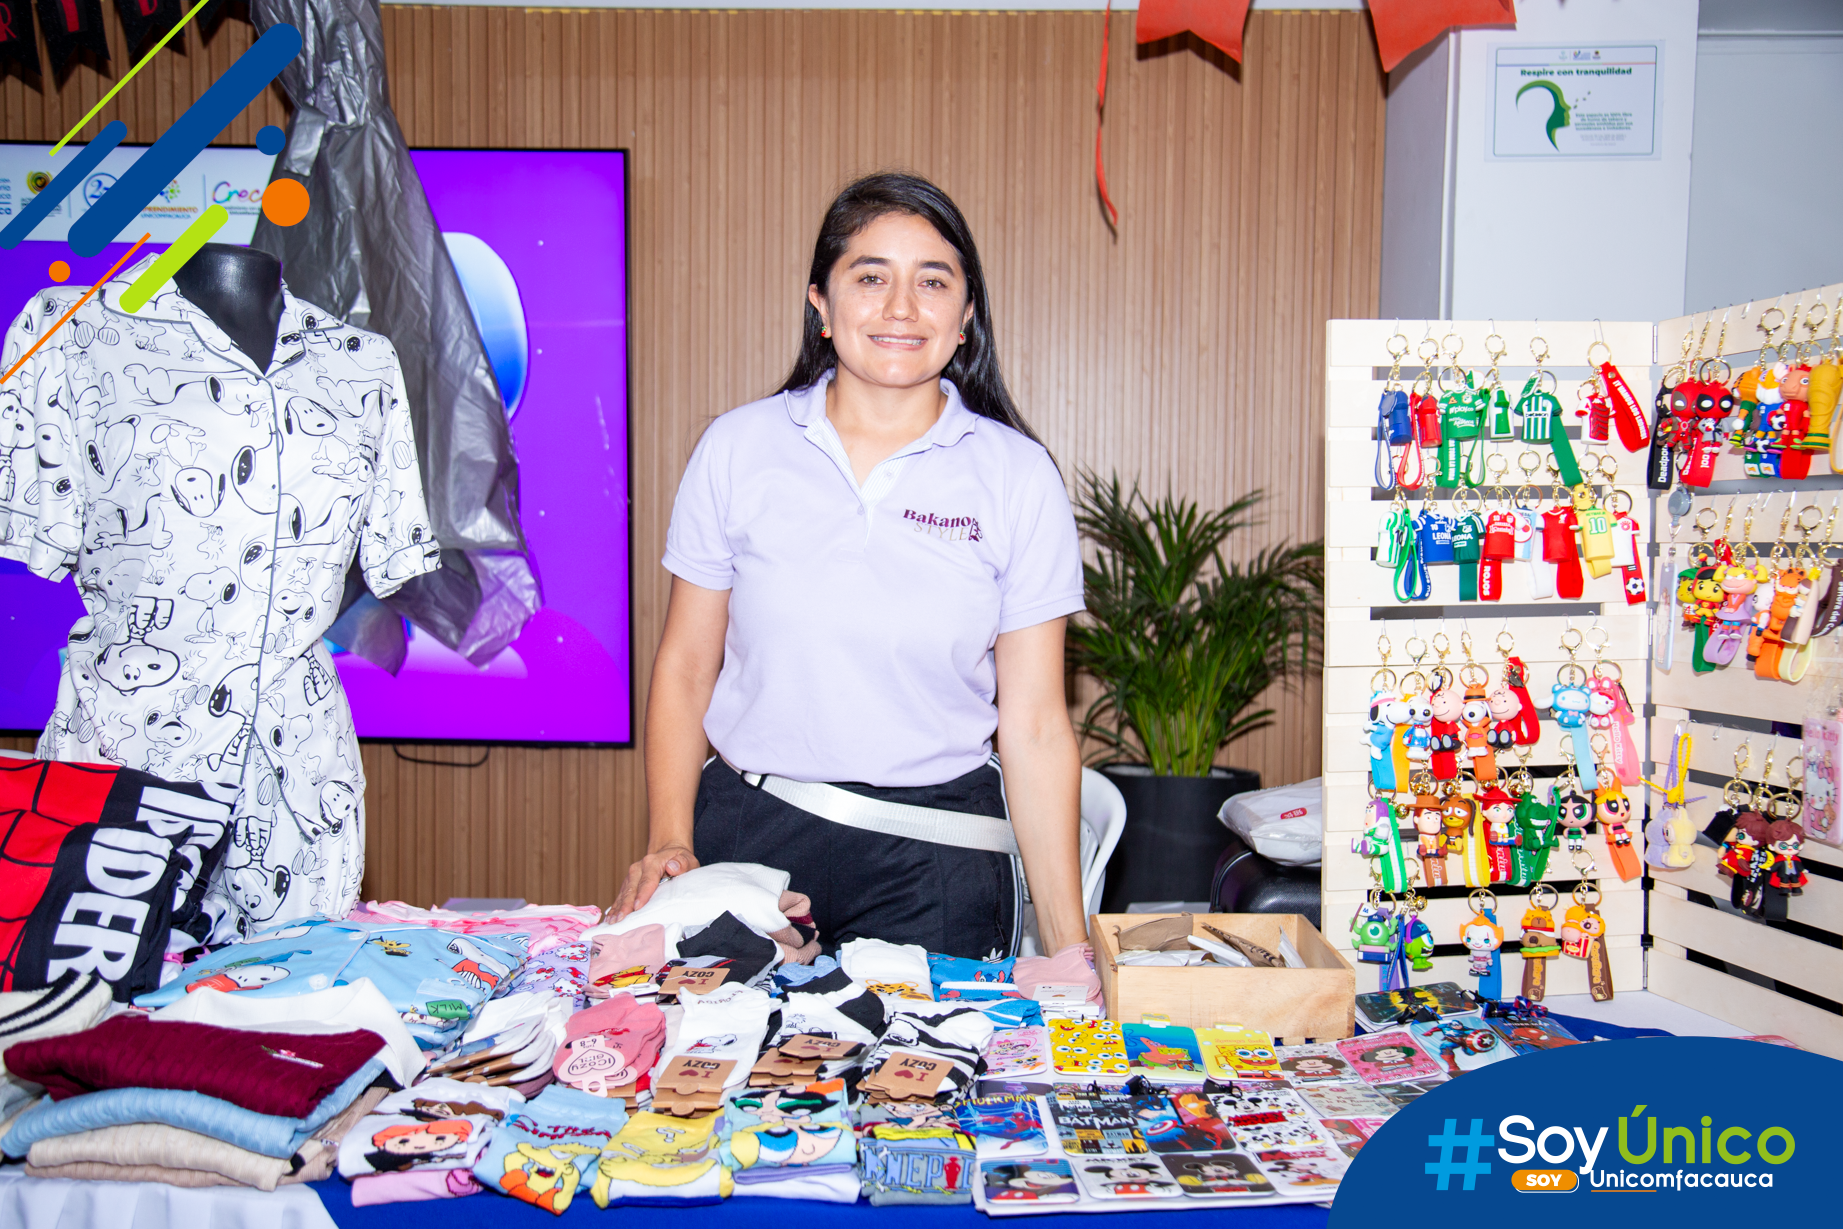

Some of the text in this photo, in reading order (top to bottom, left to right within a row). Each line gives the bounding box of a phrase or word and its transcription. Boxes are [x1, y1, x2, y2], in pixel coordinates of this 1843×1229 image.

[1520, 68, 1554, 77] Respire
[1576, 67, 1632, 76] tranquilidad
[1617, 385, 1635, 406] VAMOS
[1629, 404, 1640, 417] LOS
[1658, 444, 1668, 483] Deadpo
[903, 509, 971, 528] Bakano
[1589, 517, 1608, 534] 10
[914, 522, 968, 541] STYLE
[1482, 566, 1492, 596] ROJOS
[686, 970, 716, 978] COZY
[431, 1002, 462, 1014] MILK
[683, 1060, 720, 1070] COZY
[900, 1058, 938, 1072] COZY
[1058, 1113, 1136, 1130] BATMAN
